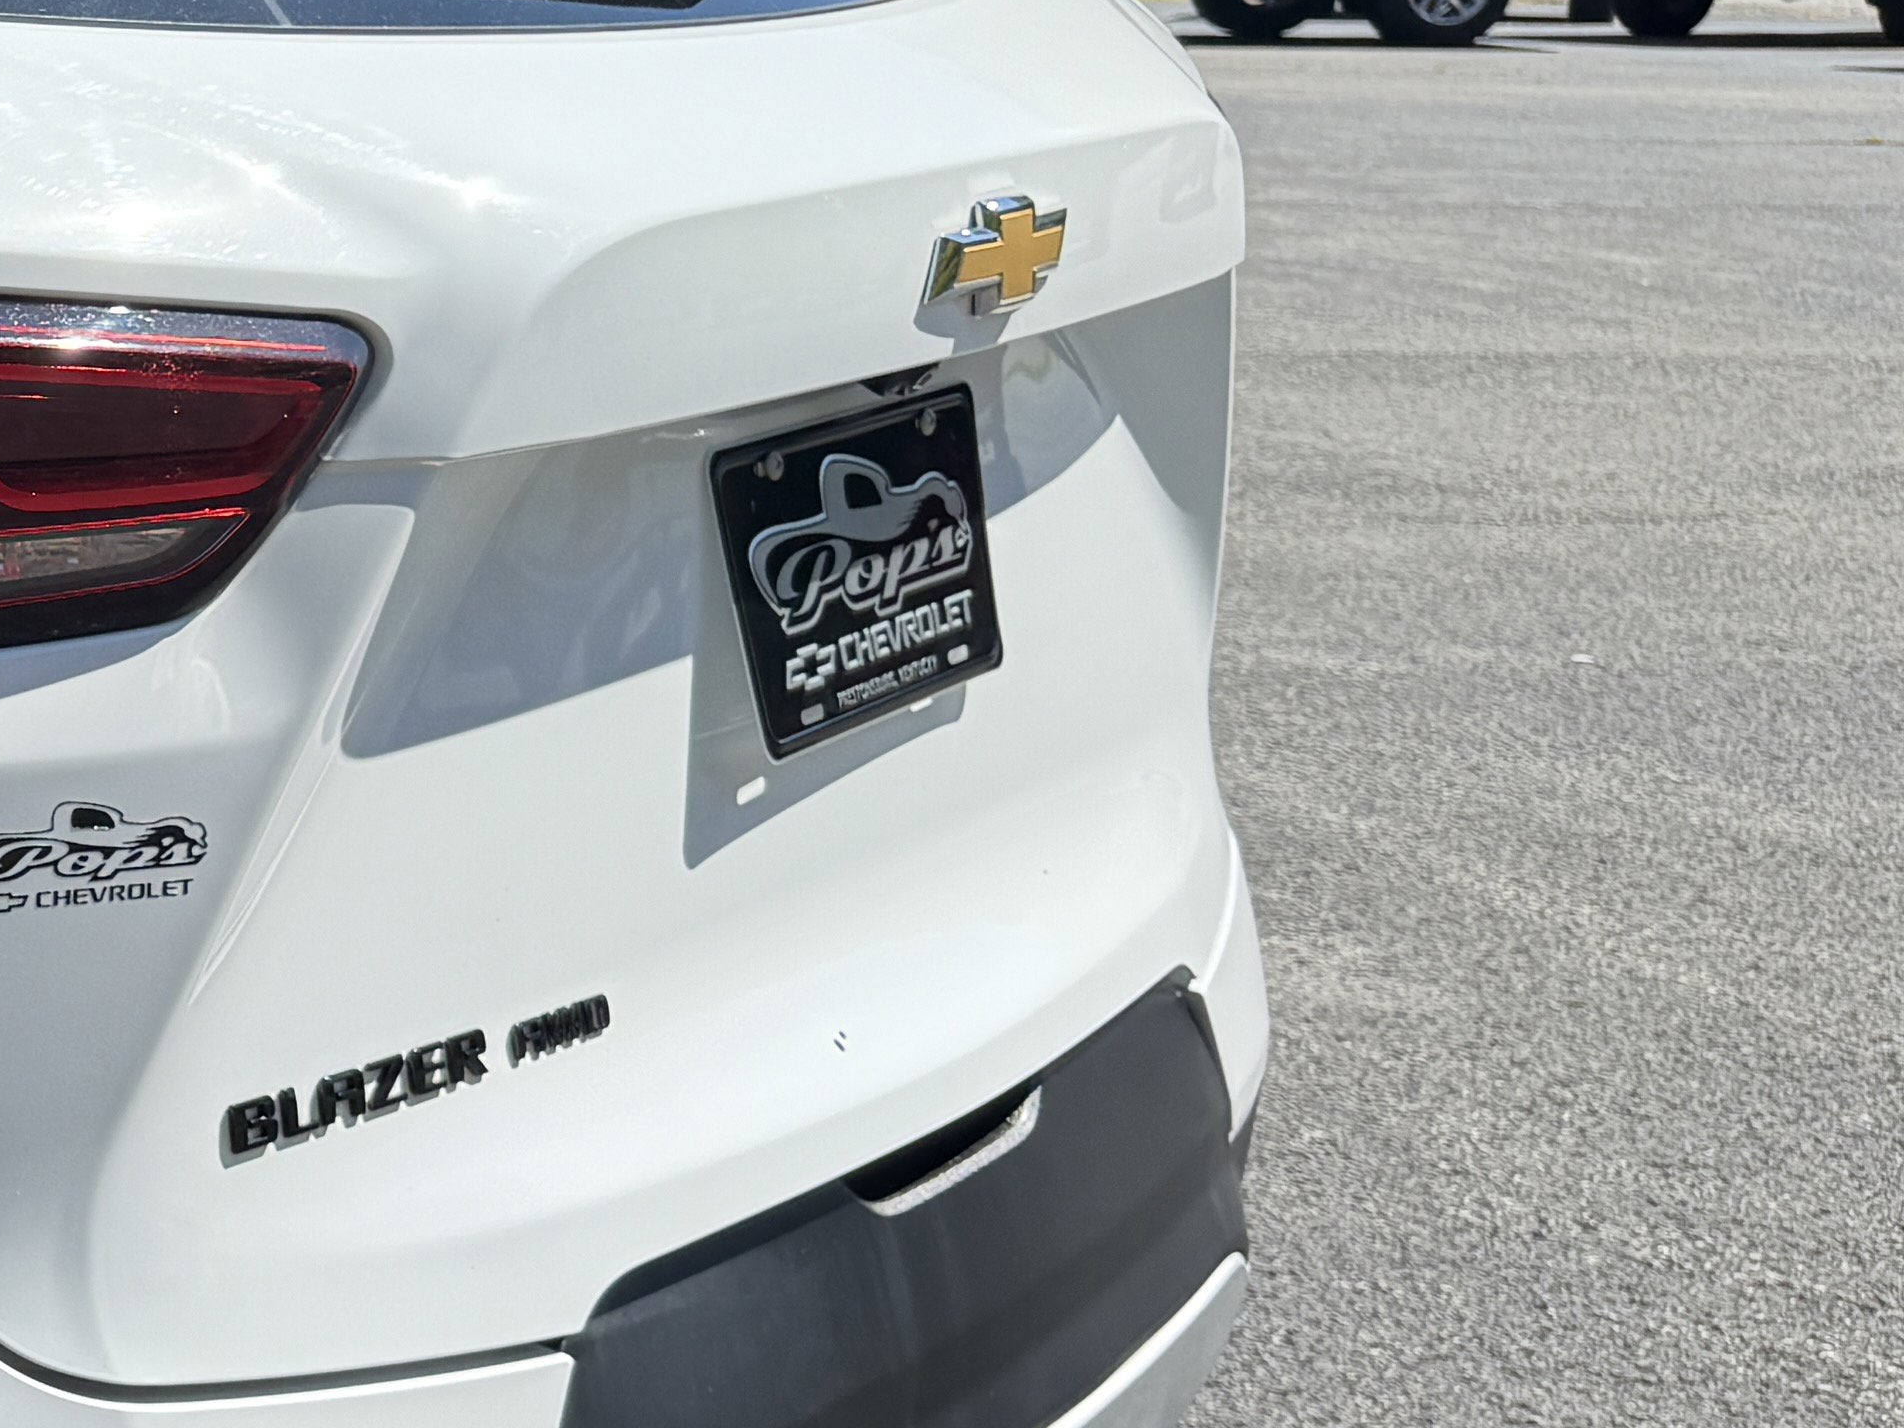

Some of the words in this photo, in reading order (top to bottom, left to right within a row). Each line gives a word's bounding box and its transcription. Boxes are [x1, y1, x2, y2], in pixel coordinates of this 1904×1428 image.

[837, 588, 974, 671] CHEVROLET
[34, 877, 195, 909] CHEVROLET
[220, 1028, 490, 1164] BLAZER
